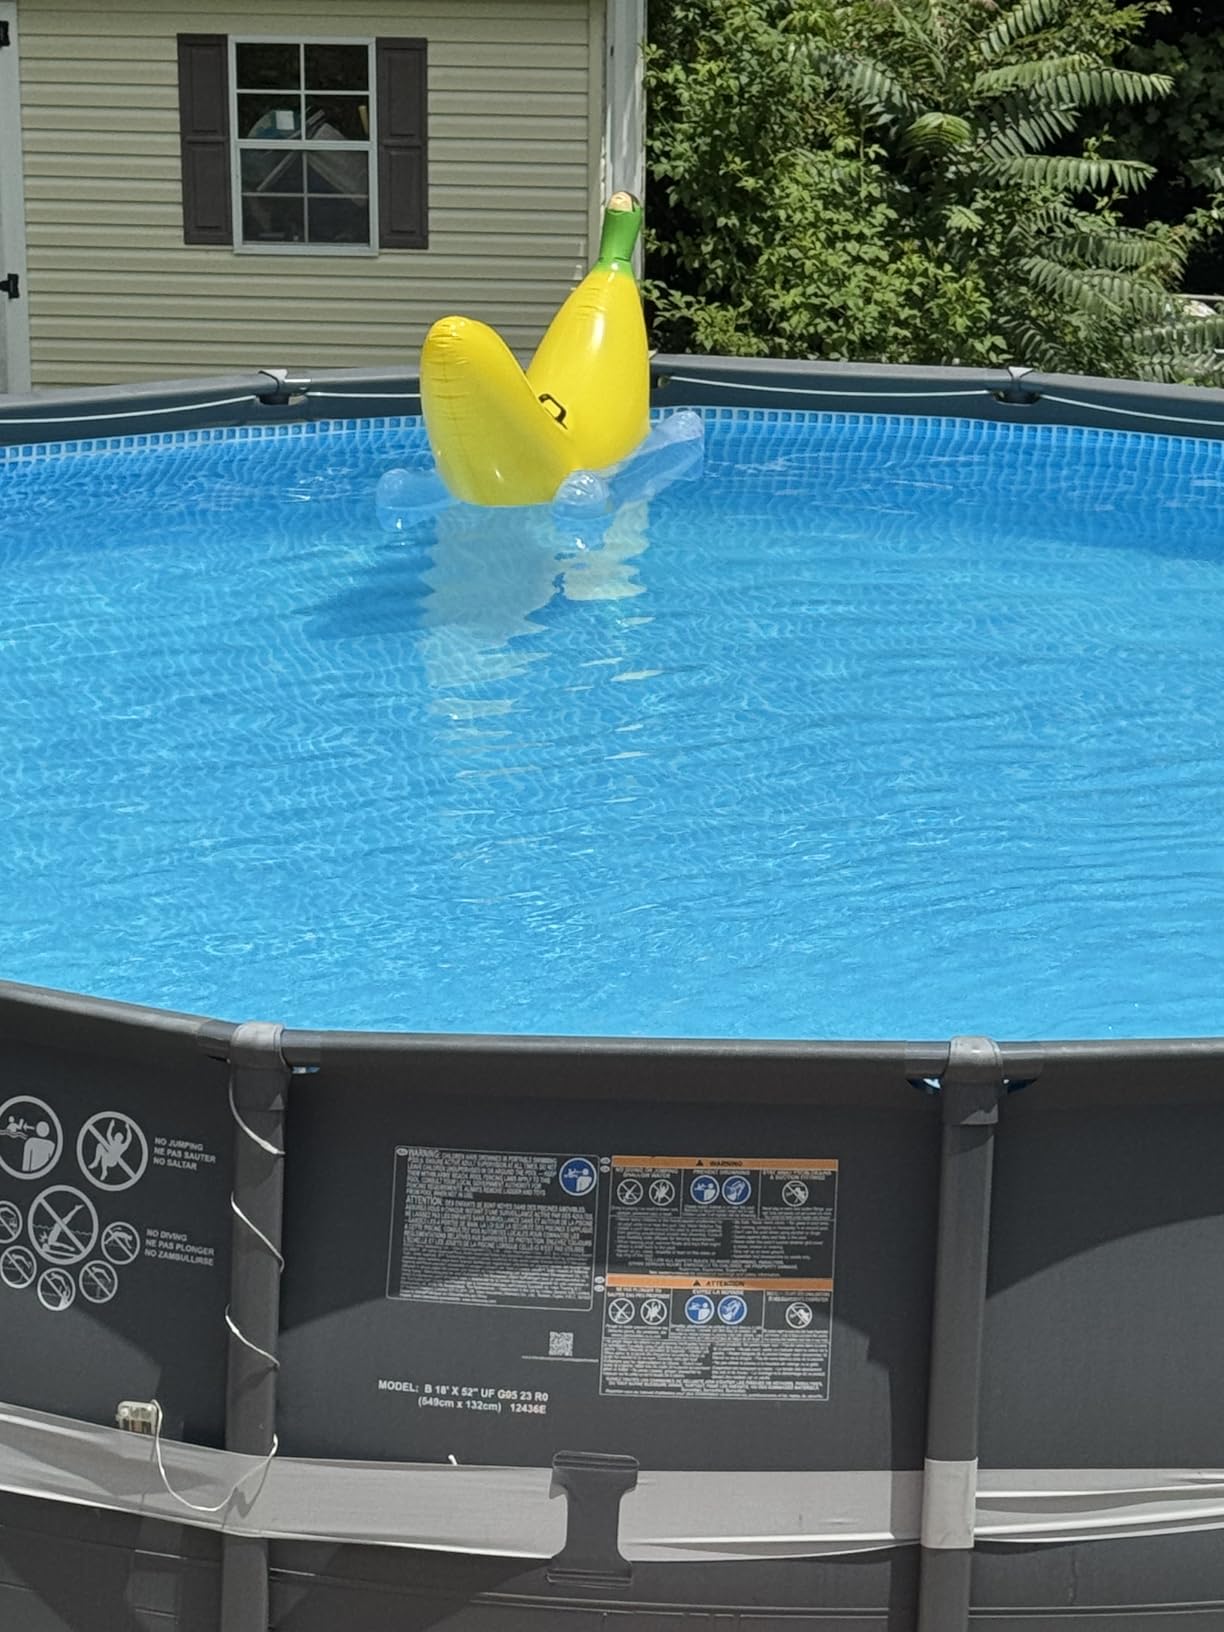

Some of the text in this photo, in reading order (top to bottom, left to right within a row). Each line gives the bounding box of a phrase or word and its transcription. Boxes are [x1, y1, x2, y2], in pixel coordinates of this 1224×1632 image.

[154, 1136, 204, 1151] NO JUMPING
[153, 1146, 216, 1164] NE PAS SAUTER
[153, 1156, 198, 1170] NO SALTAR
[146, 1228, 188, 1242] NO DIVING
[145, 1238, 215, 1257] NE PAS PLONGER
[144, 1248, 214, 1266] NO ZAMBULLIRSE
[378, 1379, 419, 1393] MODEL:
[424, 1383, 433, 1394] B
[435, 1385, 450, 1395] 18'
[451, 1385, 460, 1396] X
[461, 1386, 479, 1397] 52"
[480, 1387, 496, 1399] UF
[497, 1388, 518, 1400] G05
[519, 1390, 533, 1401] 23
[418, 1396, 547, 1415] (549cm x 132cm) 12436E
